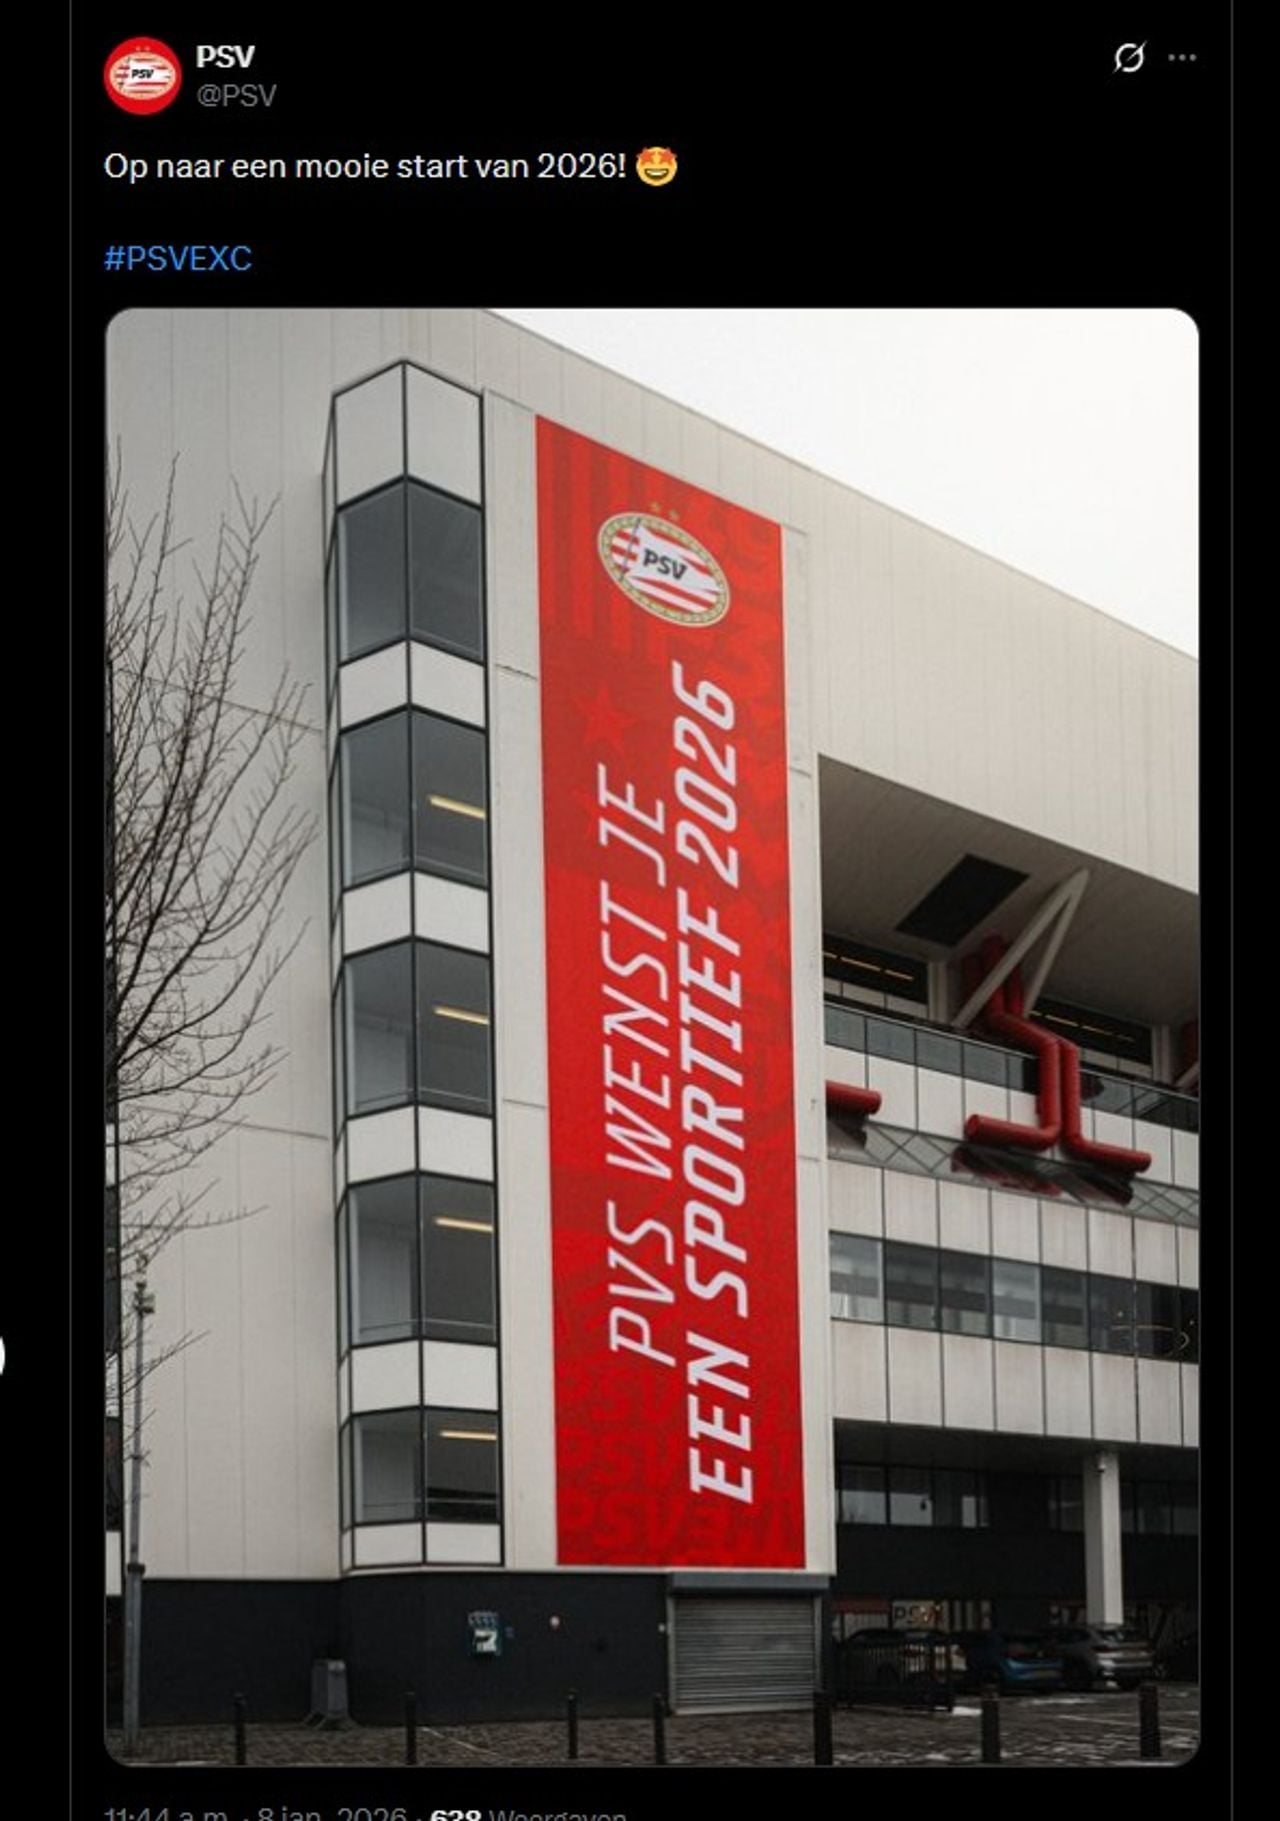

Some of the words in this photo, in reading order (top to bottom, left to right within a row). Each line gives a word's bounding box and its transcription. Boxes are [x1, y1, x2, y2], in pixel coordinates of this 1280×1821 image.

[643, 548, 687, 581] PSV
[597, 763, 666, 887] JE
[672, 660, 739, 888] 2026
[600, 880, 672, 1179] WENST
[676, 887, 748, 1318] SPORTIEF
[607, 1200, 676, 1367] PVS
[687, 1331, 753, 1503] EEN
